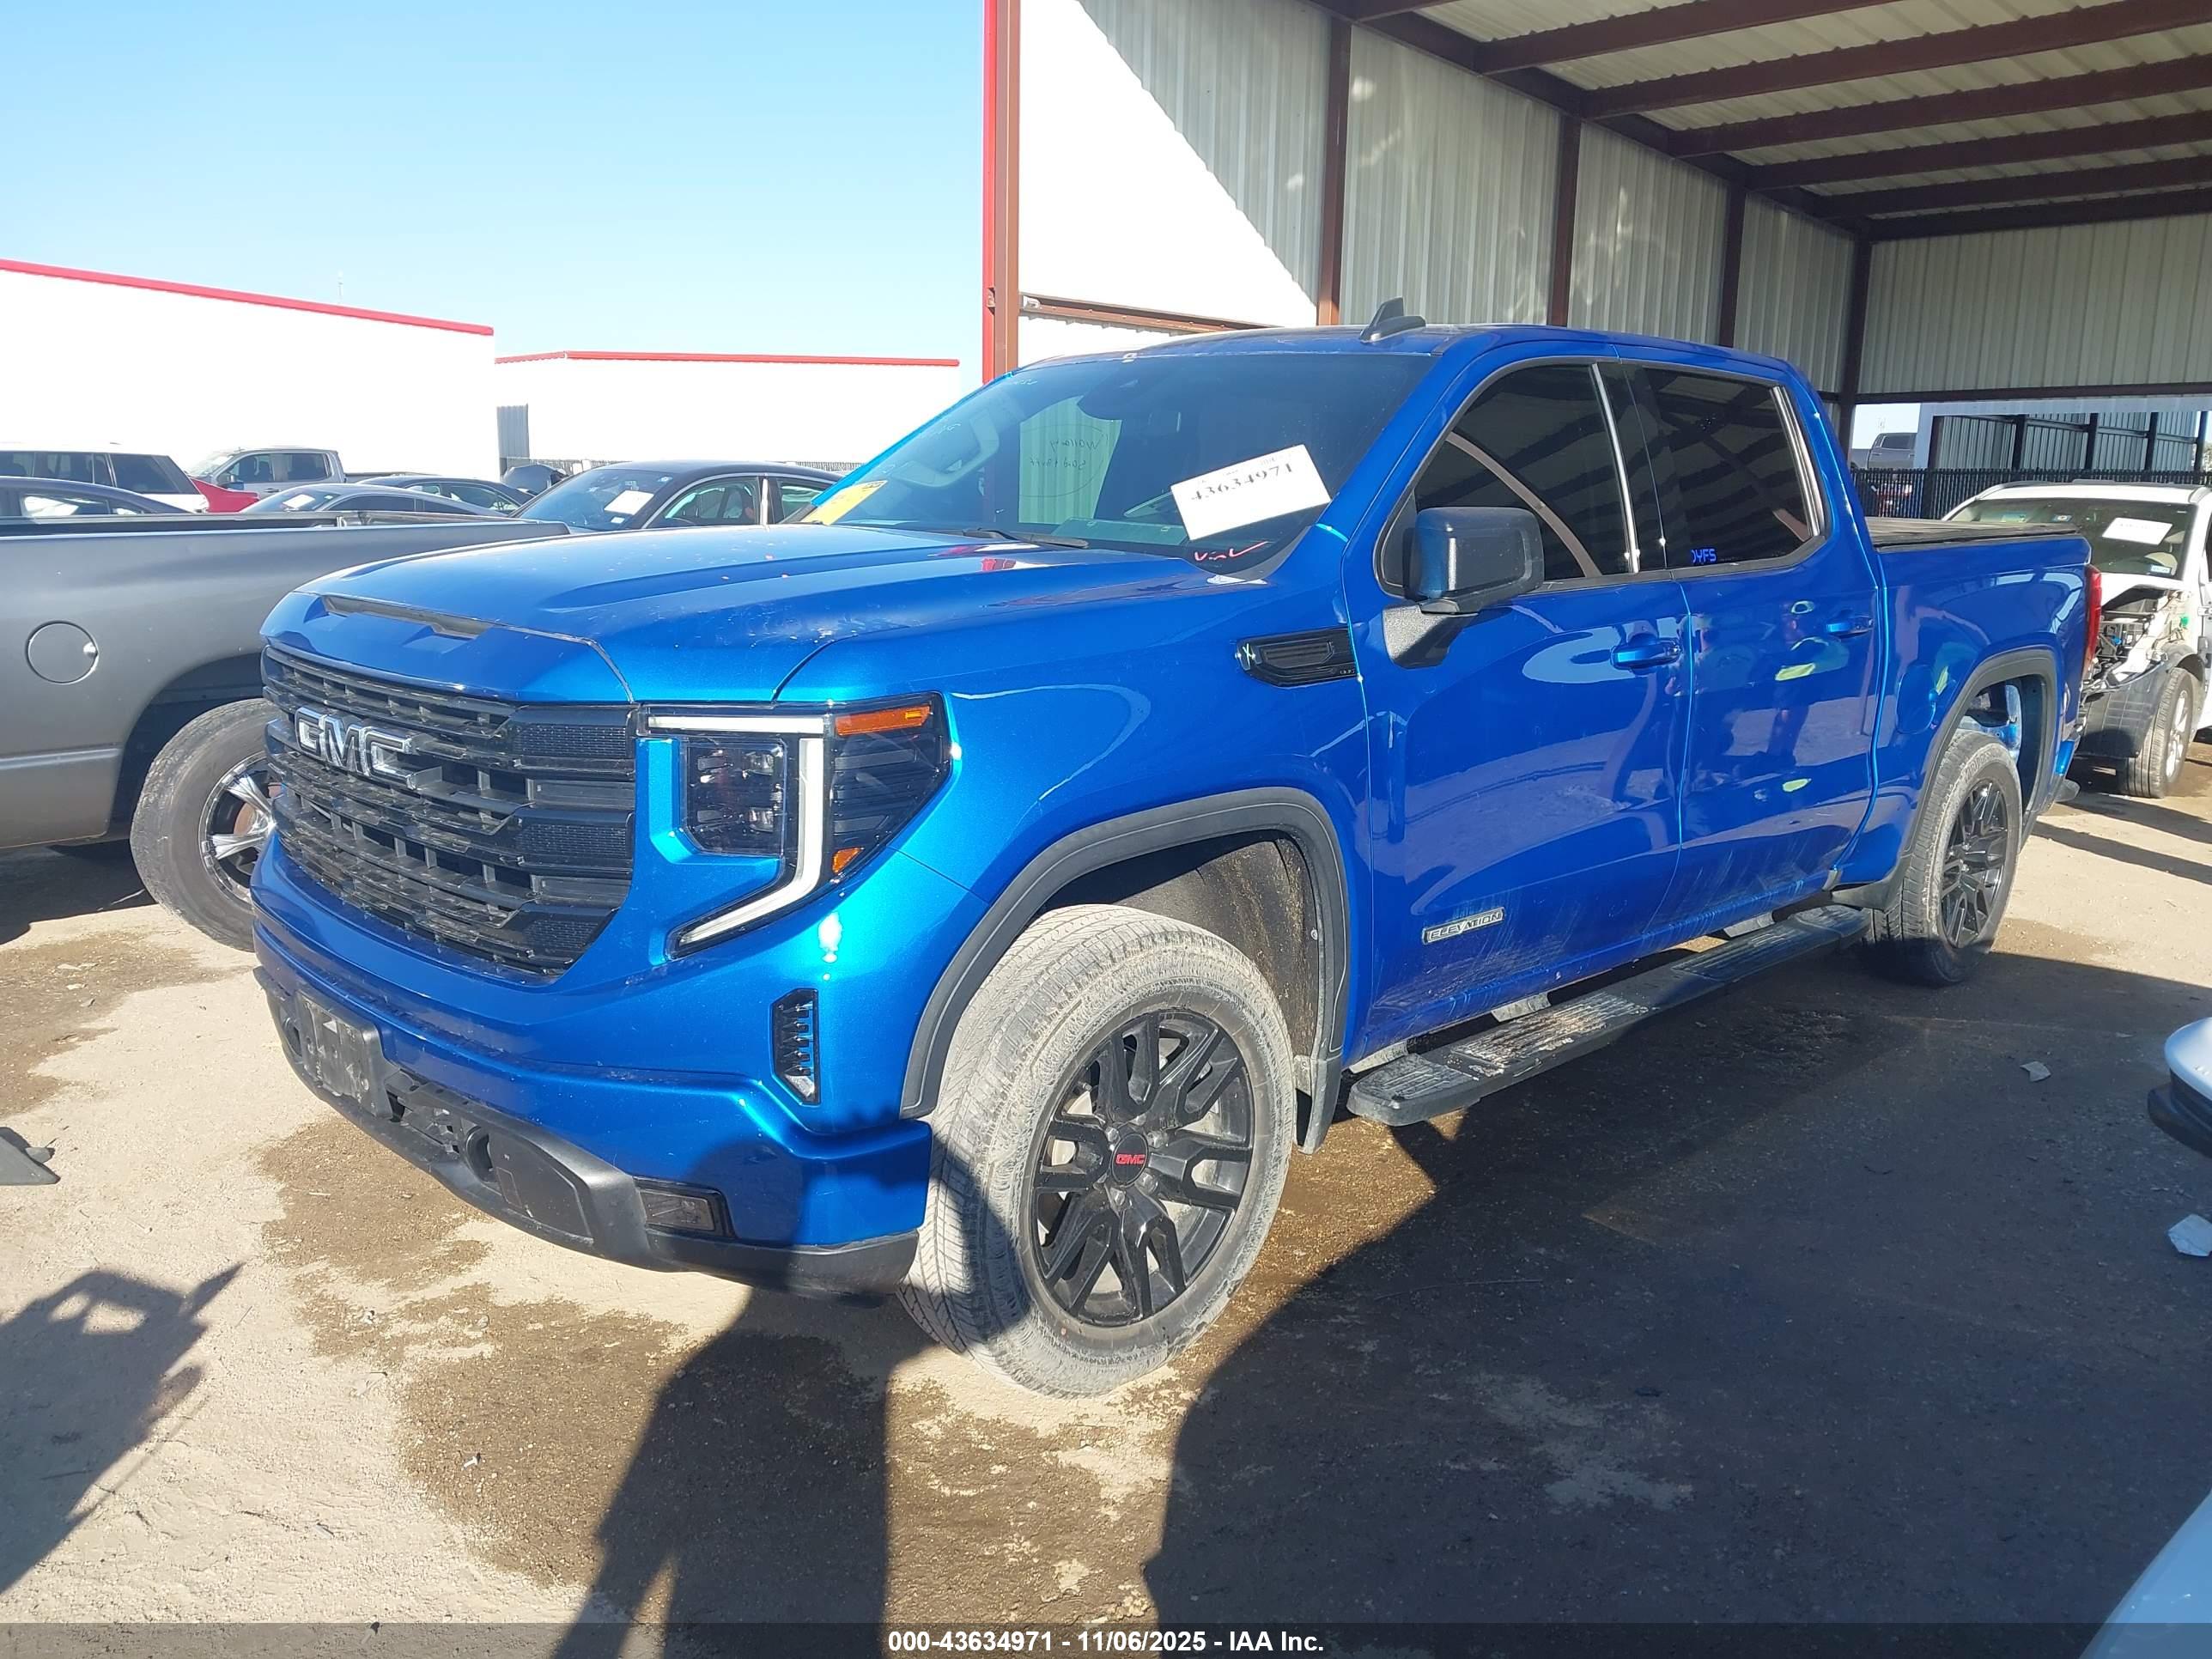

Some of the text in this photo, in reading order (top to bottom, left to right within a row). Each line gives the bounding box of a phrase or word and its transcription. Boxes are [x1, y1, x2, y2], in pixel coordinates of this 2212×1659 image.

[1190, 462, 1293, 501] 43634971
[295, 706, 417, 790] GMC
[1430, 911, 1502, 940] ELEVATION
[1115, 1153, 1146, 1165] GMC
